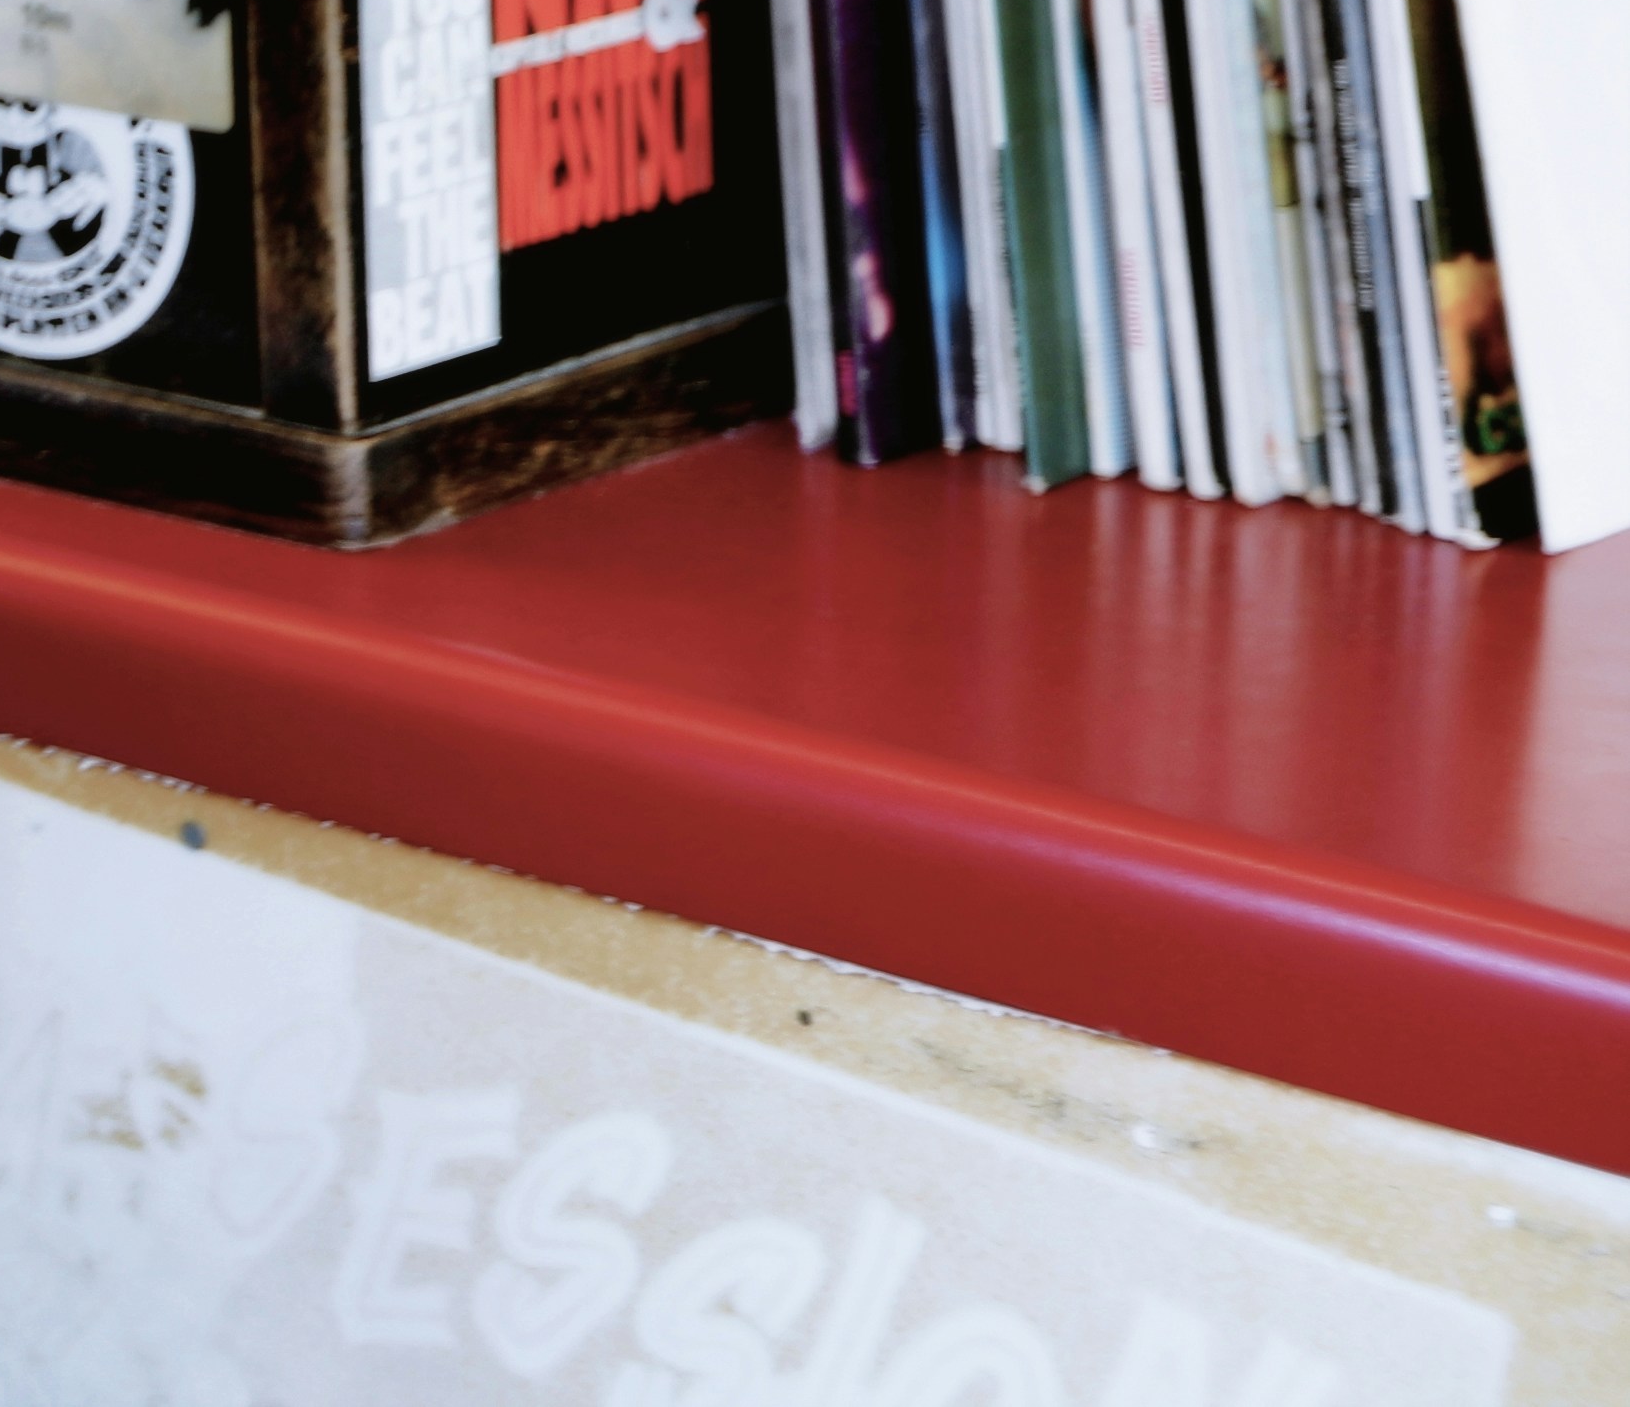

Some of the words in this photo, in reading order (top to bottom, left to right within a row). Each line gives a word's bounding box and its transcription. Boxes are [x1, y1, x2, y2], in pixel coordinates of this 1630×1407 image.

[381, 14, 489, 117] CAN
[374, 102, 496, 204] FEEL
[399, 183, 497, 278] THE
[372, 265, 499, 373] BEAT
